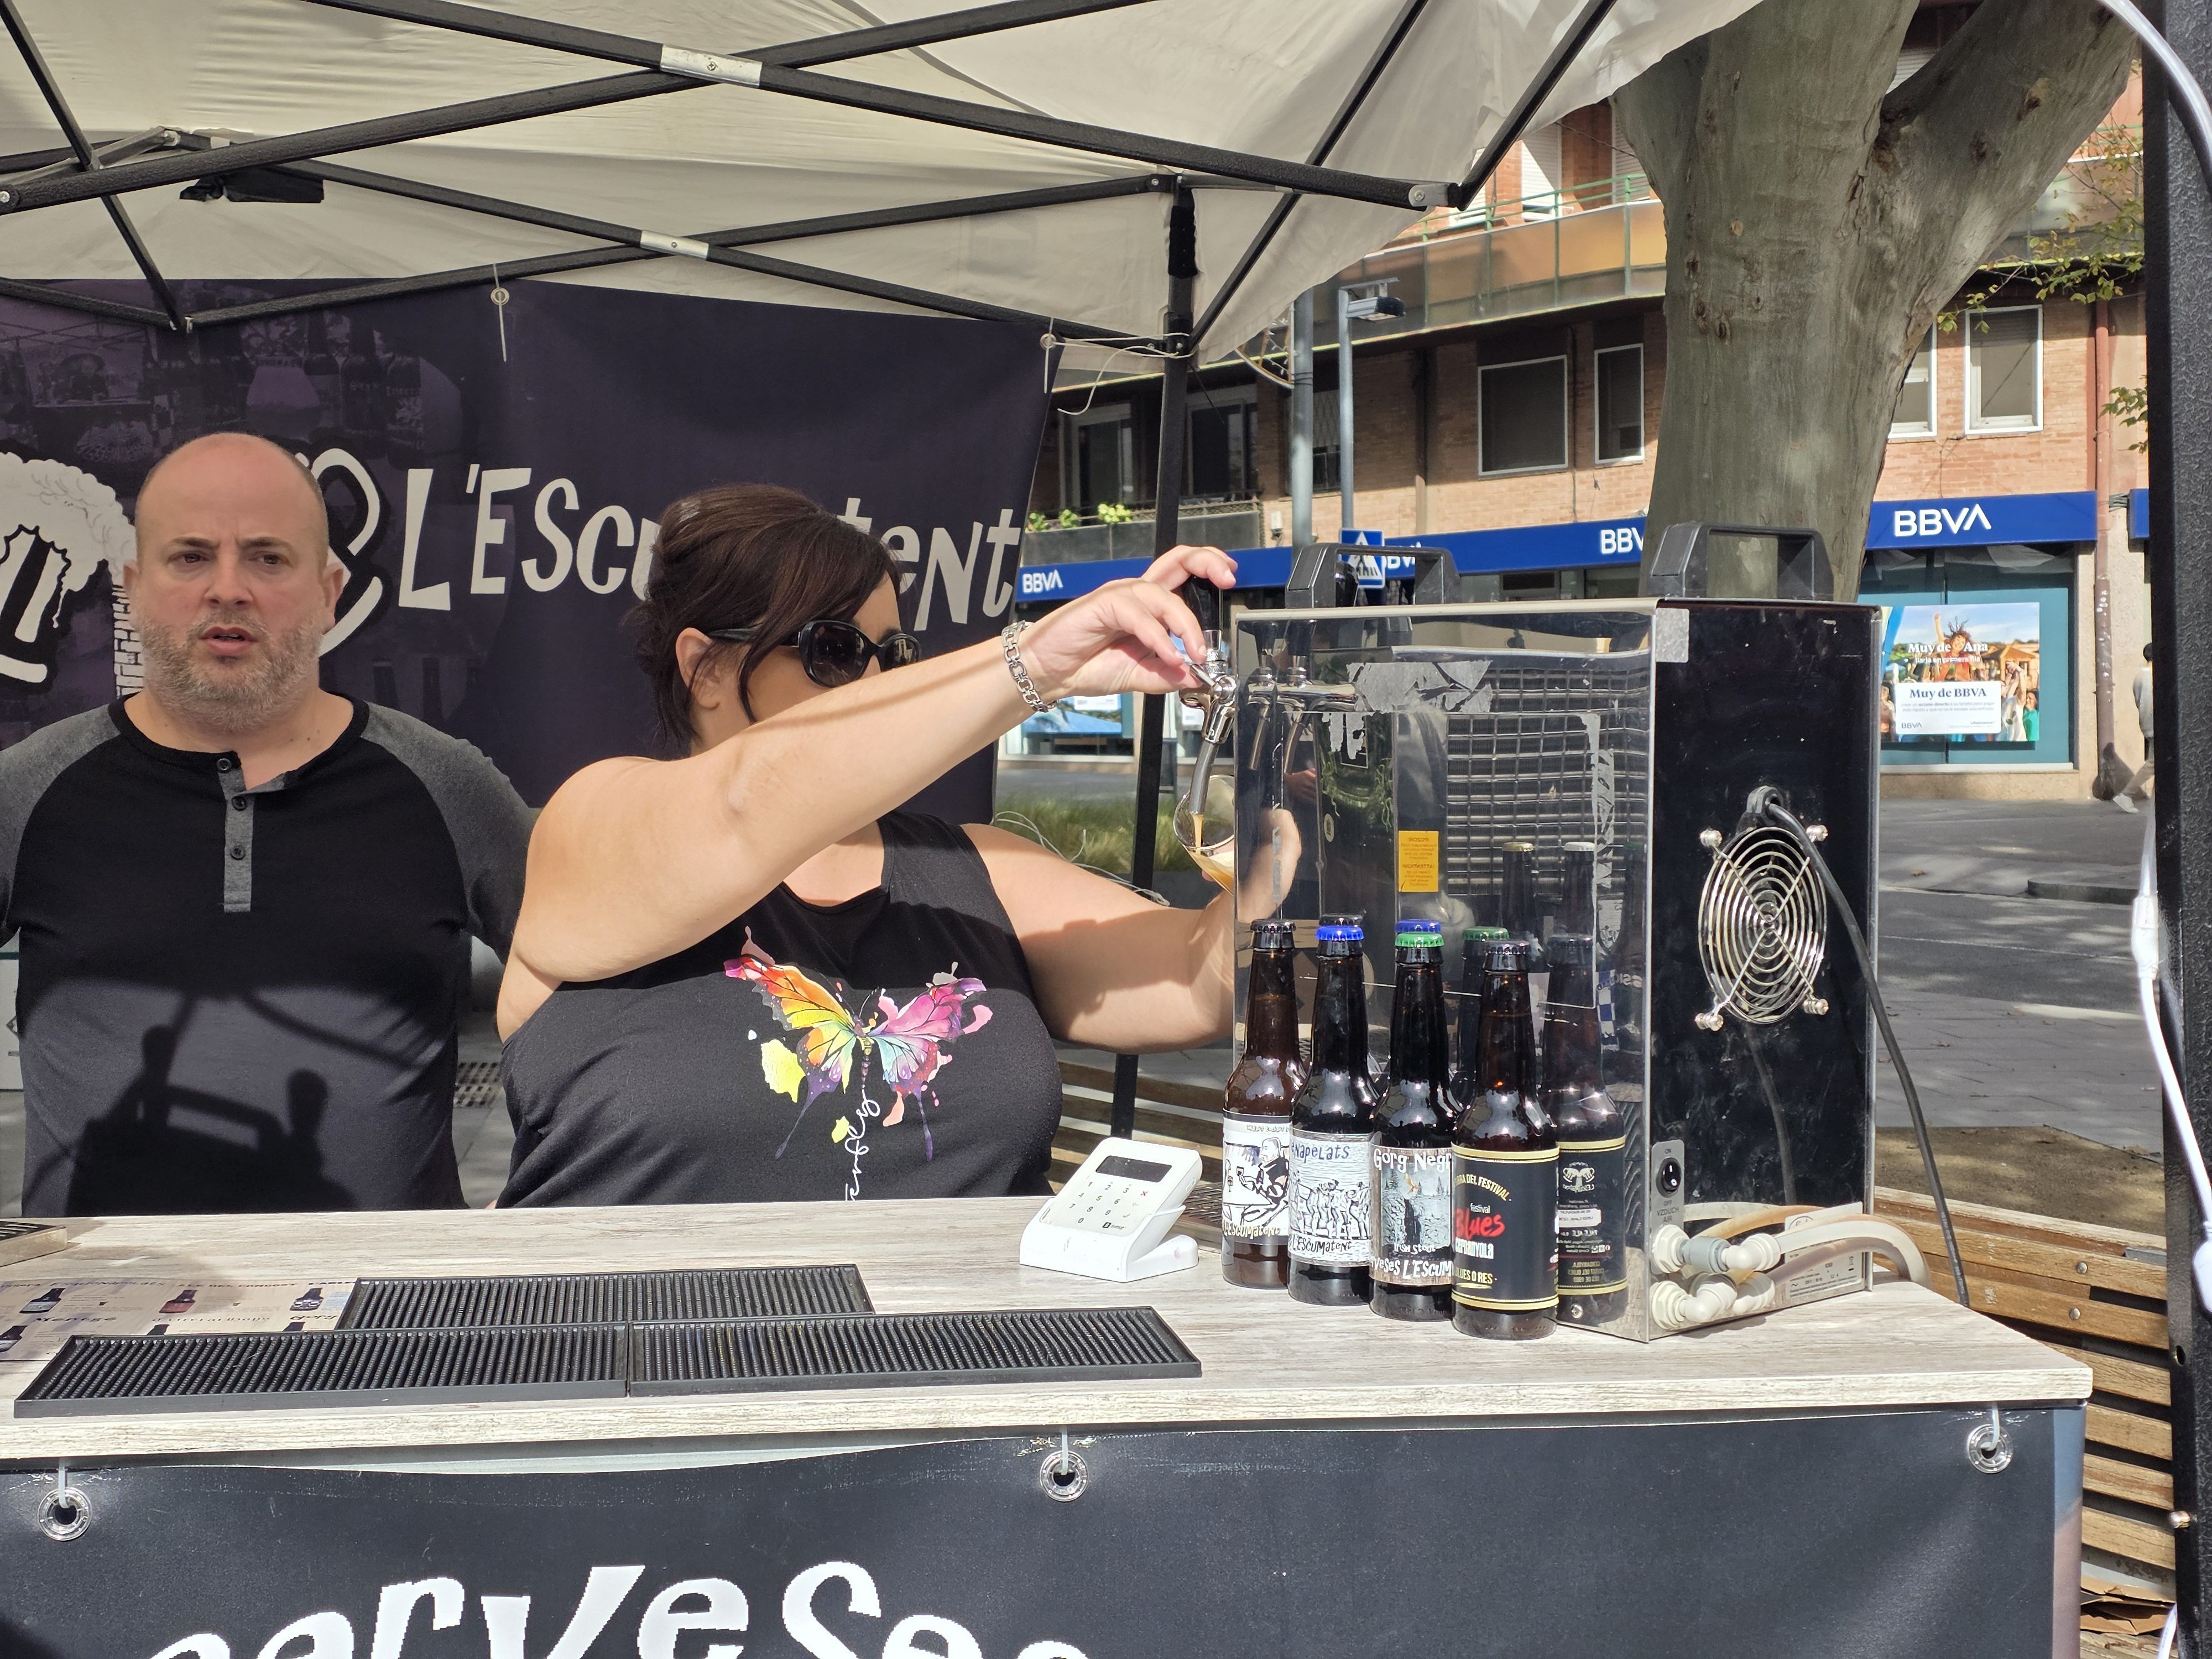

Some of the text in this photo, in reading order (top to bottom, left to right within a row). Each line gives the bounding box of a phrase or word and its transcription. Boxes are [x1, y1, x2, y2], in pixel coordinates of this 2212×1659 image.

[1894, 504, 1992, 537] BBVA
[1022, 569, 1063, 594] BBVA
[1908, 642, 1989, 655] Muy de Ana
[1910, 687, 1986, 700] Muy de BBVA
[1374, 1149, 1409, 1173] Gorg
[1467, 1174, 1478, 1185] DEL
[1478, 1176, 1510, 1201] FESTIVAL
[1470, 1202, 1491, 1214] festival
[1455, 1207, 1506, 1240] Blues
[1478, 1271, 1493, 1284] RES
